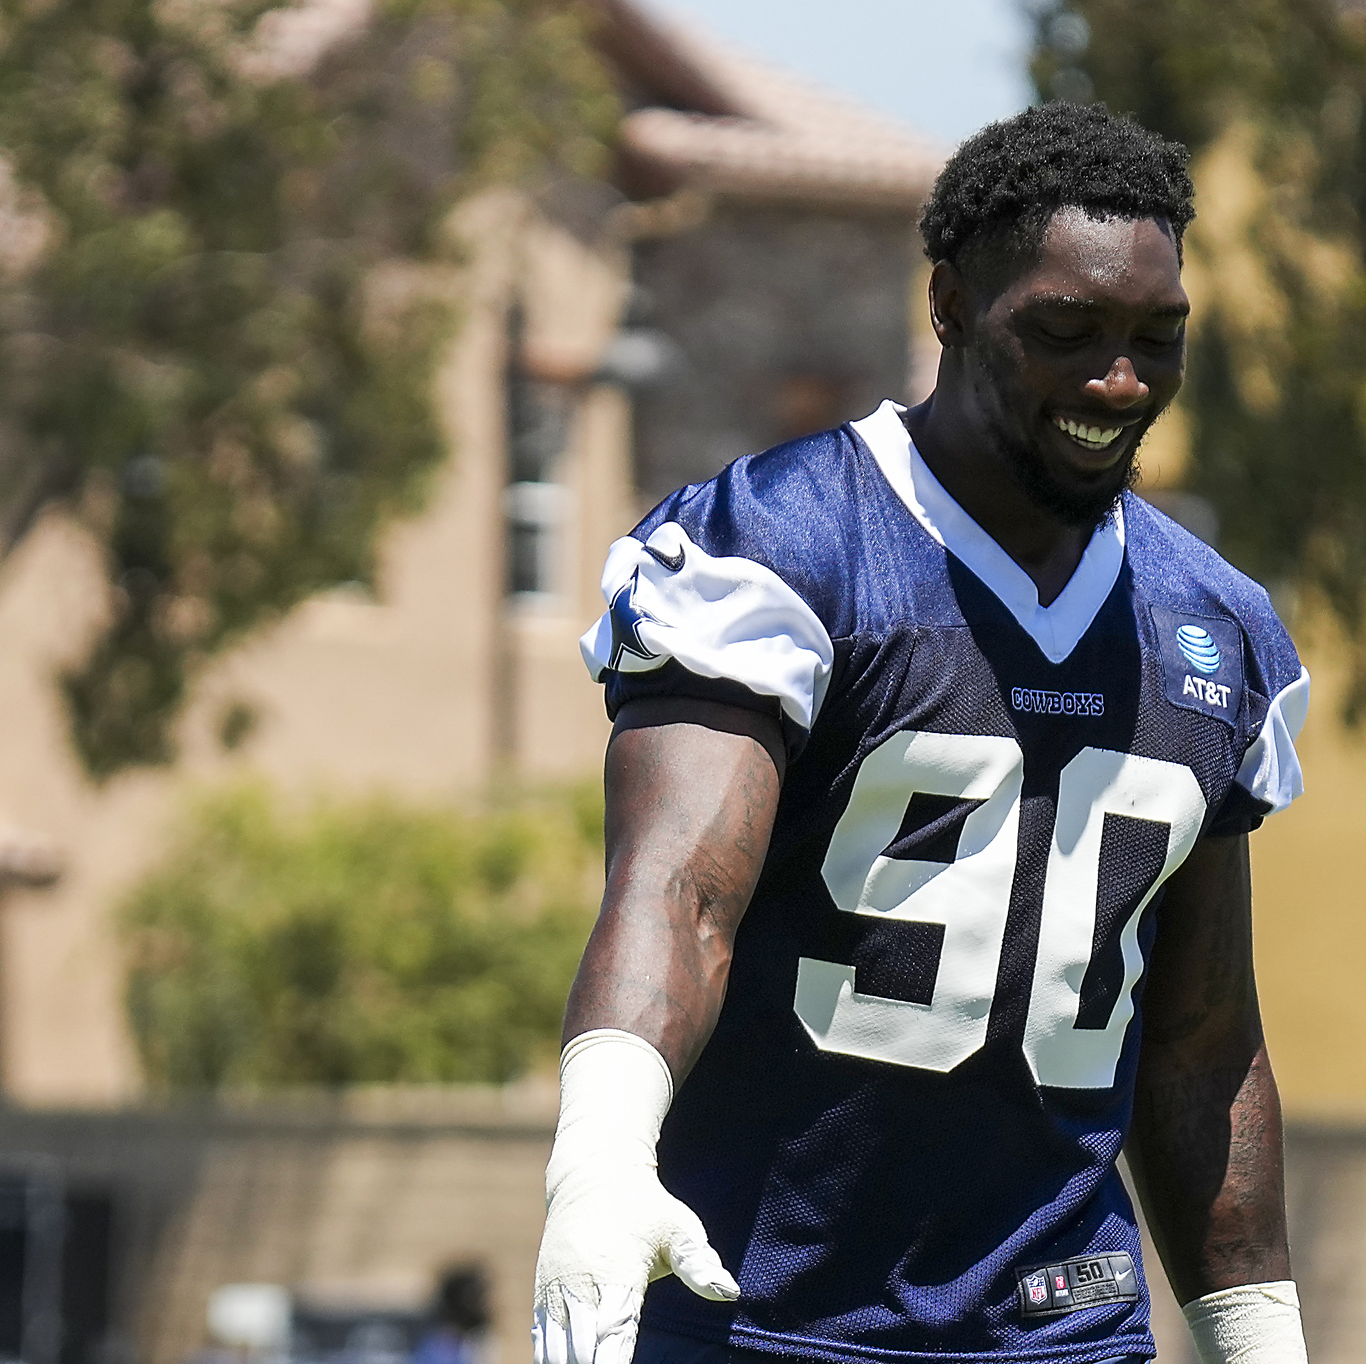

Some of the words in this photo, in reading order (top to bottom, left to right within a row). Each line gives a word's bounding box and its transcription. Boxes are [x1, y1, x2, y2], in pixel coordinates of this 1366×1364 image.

[1011, 686, 1105, 716] COWBOYS
[1182, 674, 1232, 709] AT&T
[793, 730, 1207, 1088] 90
[1076, 1261, 1104, 1282] 50
[1031, 1287, 1046, 1300] NFL
